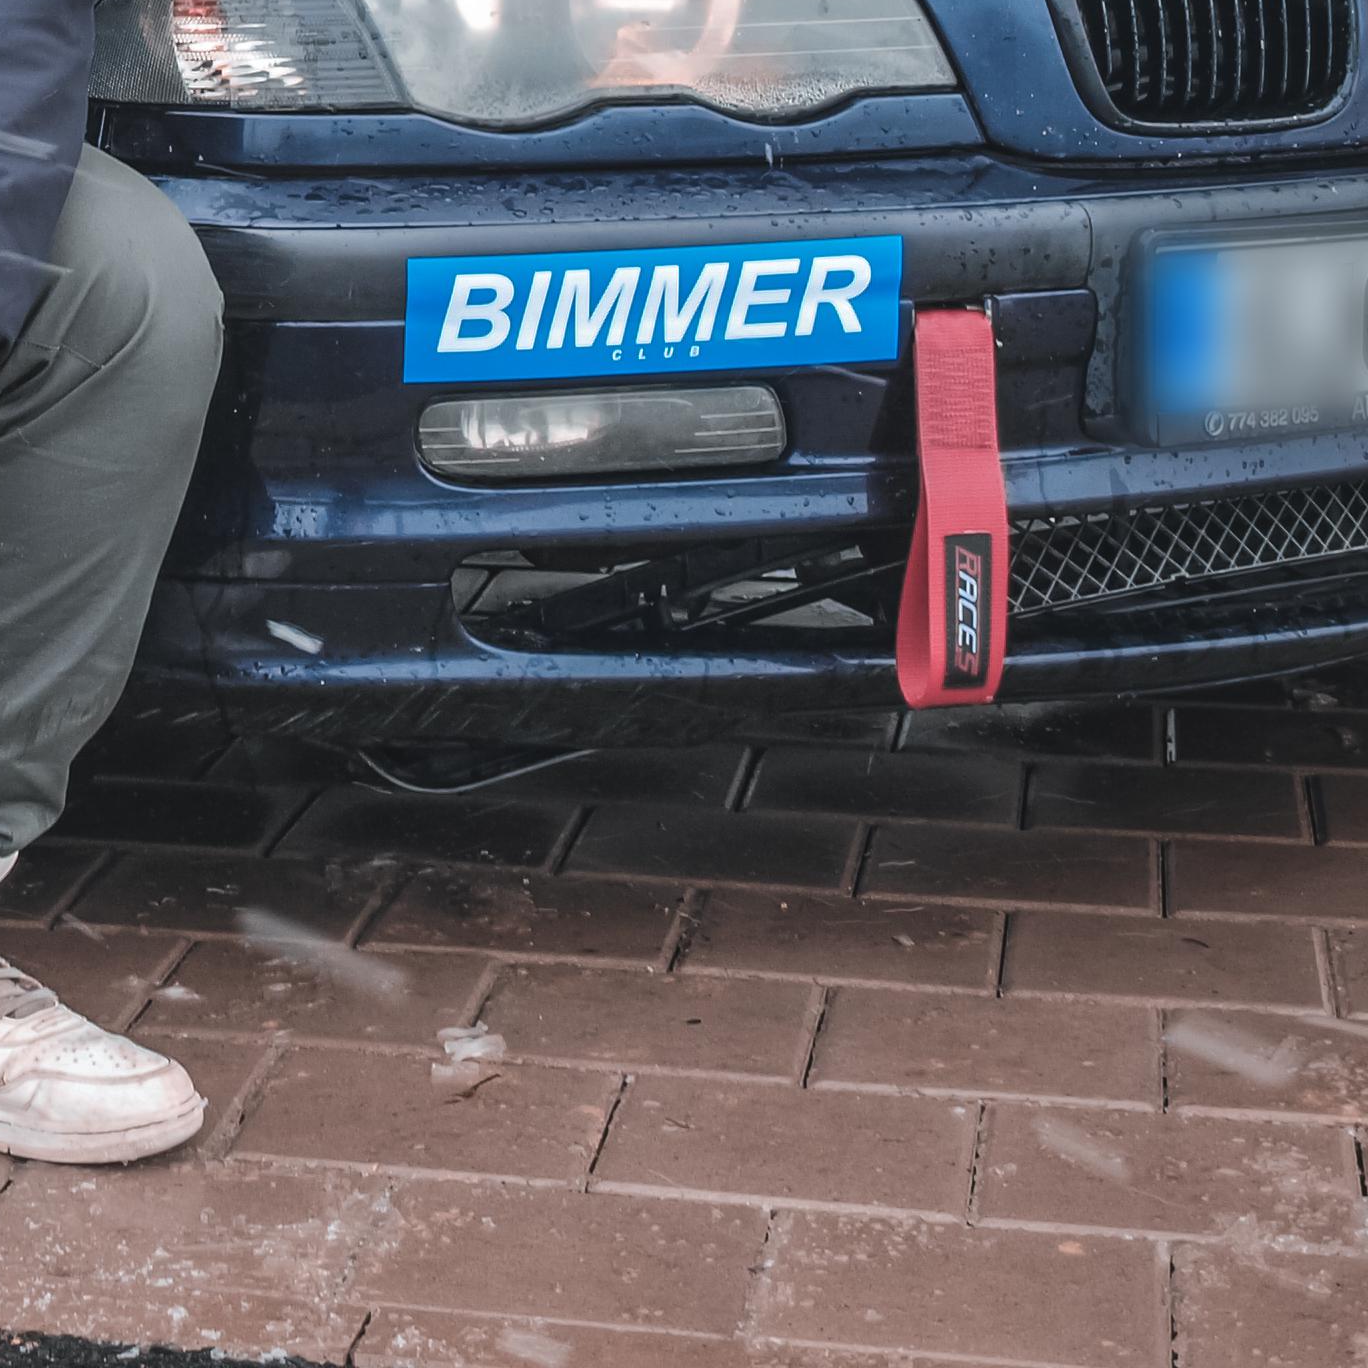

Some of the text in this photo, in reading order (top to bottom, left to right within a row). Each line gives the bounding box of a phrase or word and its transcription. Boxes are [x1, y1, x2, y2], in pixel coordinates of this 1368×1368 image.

[436, 253, 872, 353] BIMMER
[612, 345, 700, 361] CLUB
[956, 546, 981, 673] RACES
